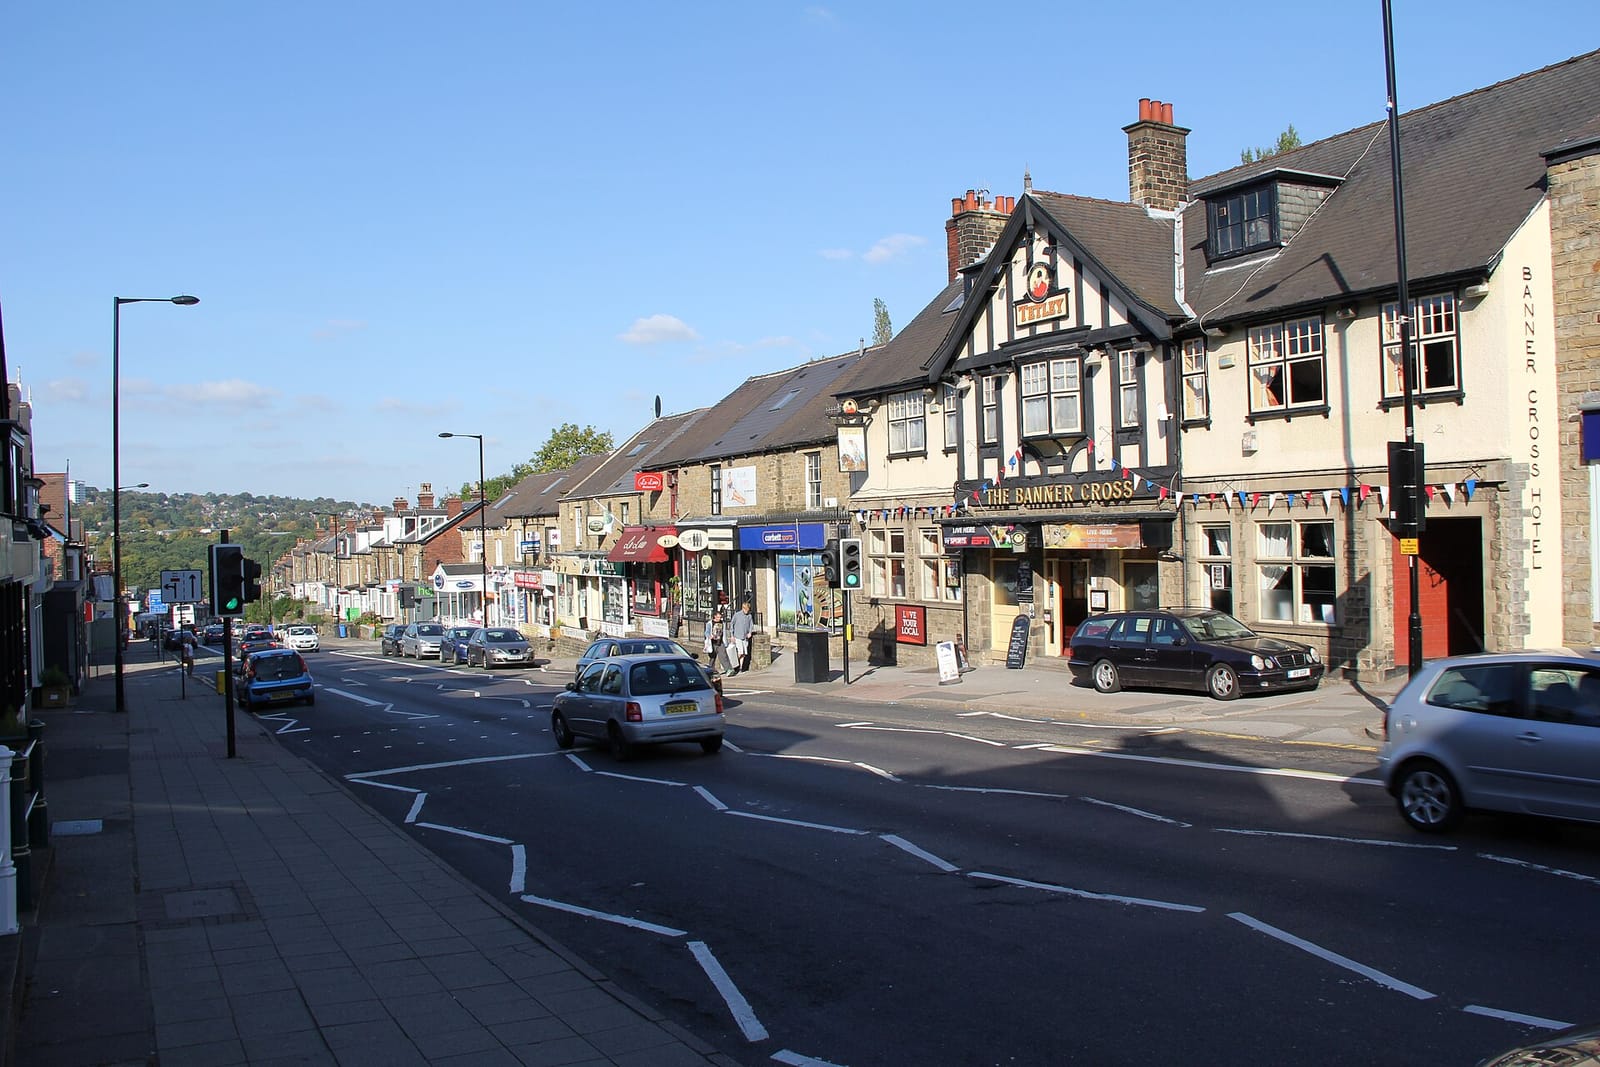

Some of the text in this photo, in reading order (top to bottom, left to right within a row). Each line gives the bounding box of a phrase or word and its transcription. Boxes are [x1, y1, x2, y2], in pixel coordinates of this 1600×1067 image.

[1018, 298, 1064, 323] TETLEY
[1522, 266, 1542, 570] BANNER CROSS HOTEL
[987, 480, 1134, 505] THE BANNER CROSS
[971, 536, 990, 545] ESPN
[901, 627, 919, 636] LOCAL
[902, 618, 917, 628] YOUR
